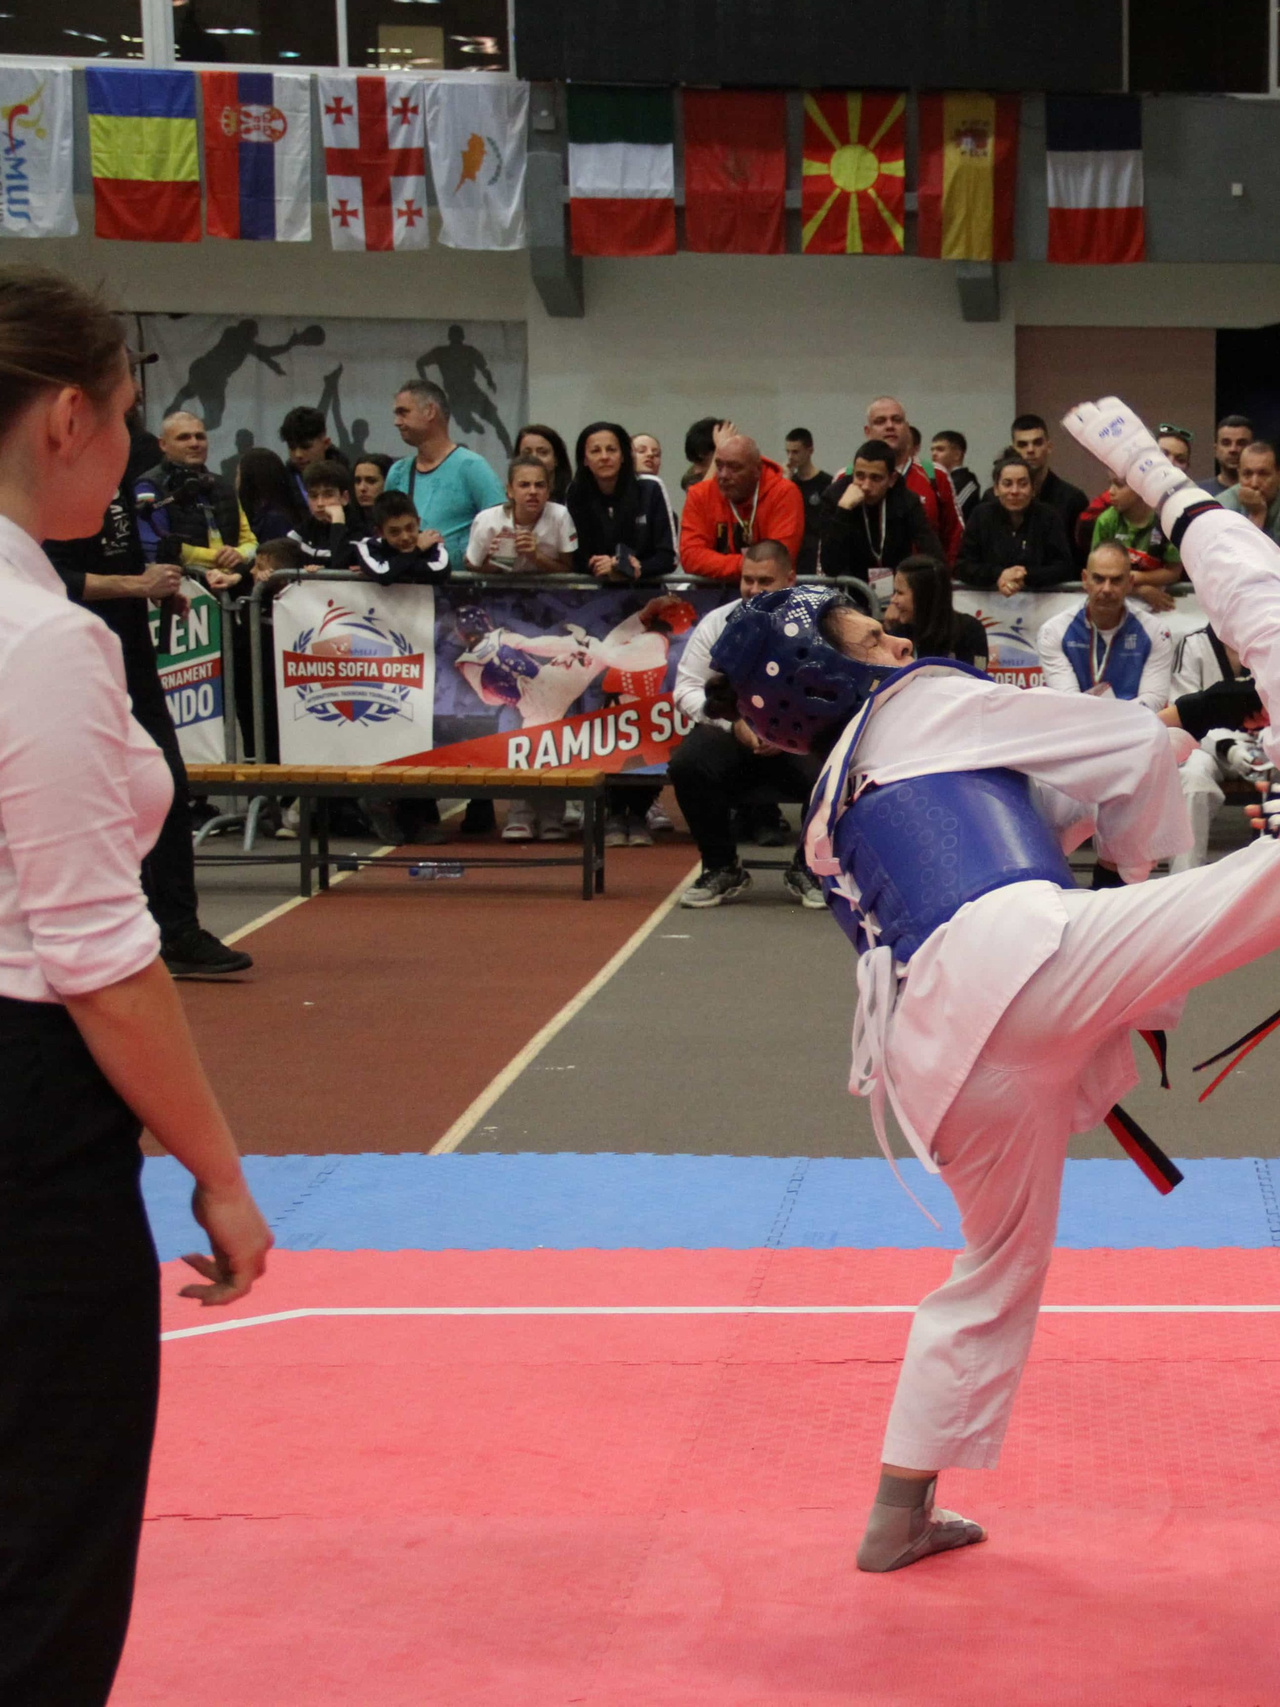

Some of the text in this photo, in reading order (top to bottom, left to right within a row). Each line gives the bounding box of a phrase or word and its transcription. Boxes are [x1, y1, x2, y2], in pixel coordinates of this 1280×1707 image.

[287, 661, 421, 679] RAMUS SOFIA OPEN
[508, 709, 640, 770] RAMUS
